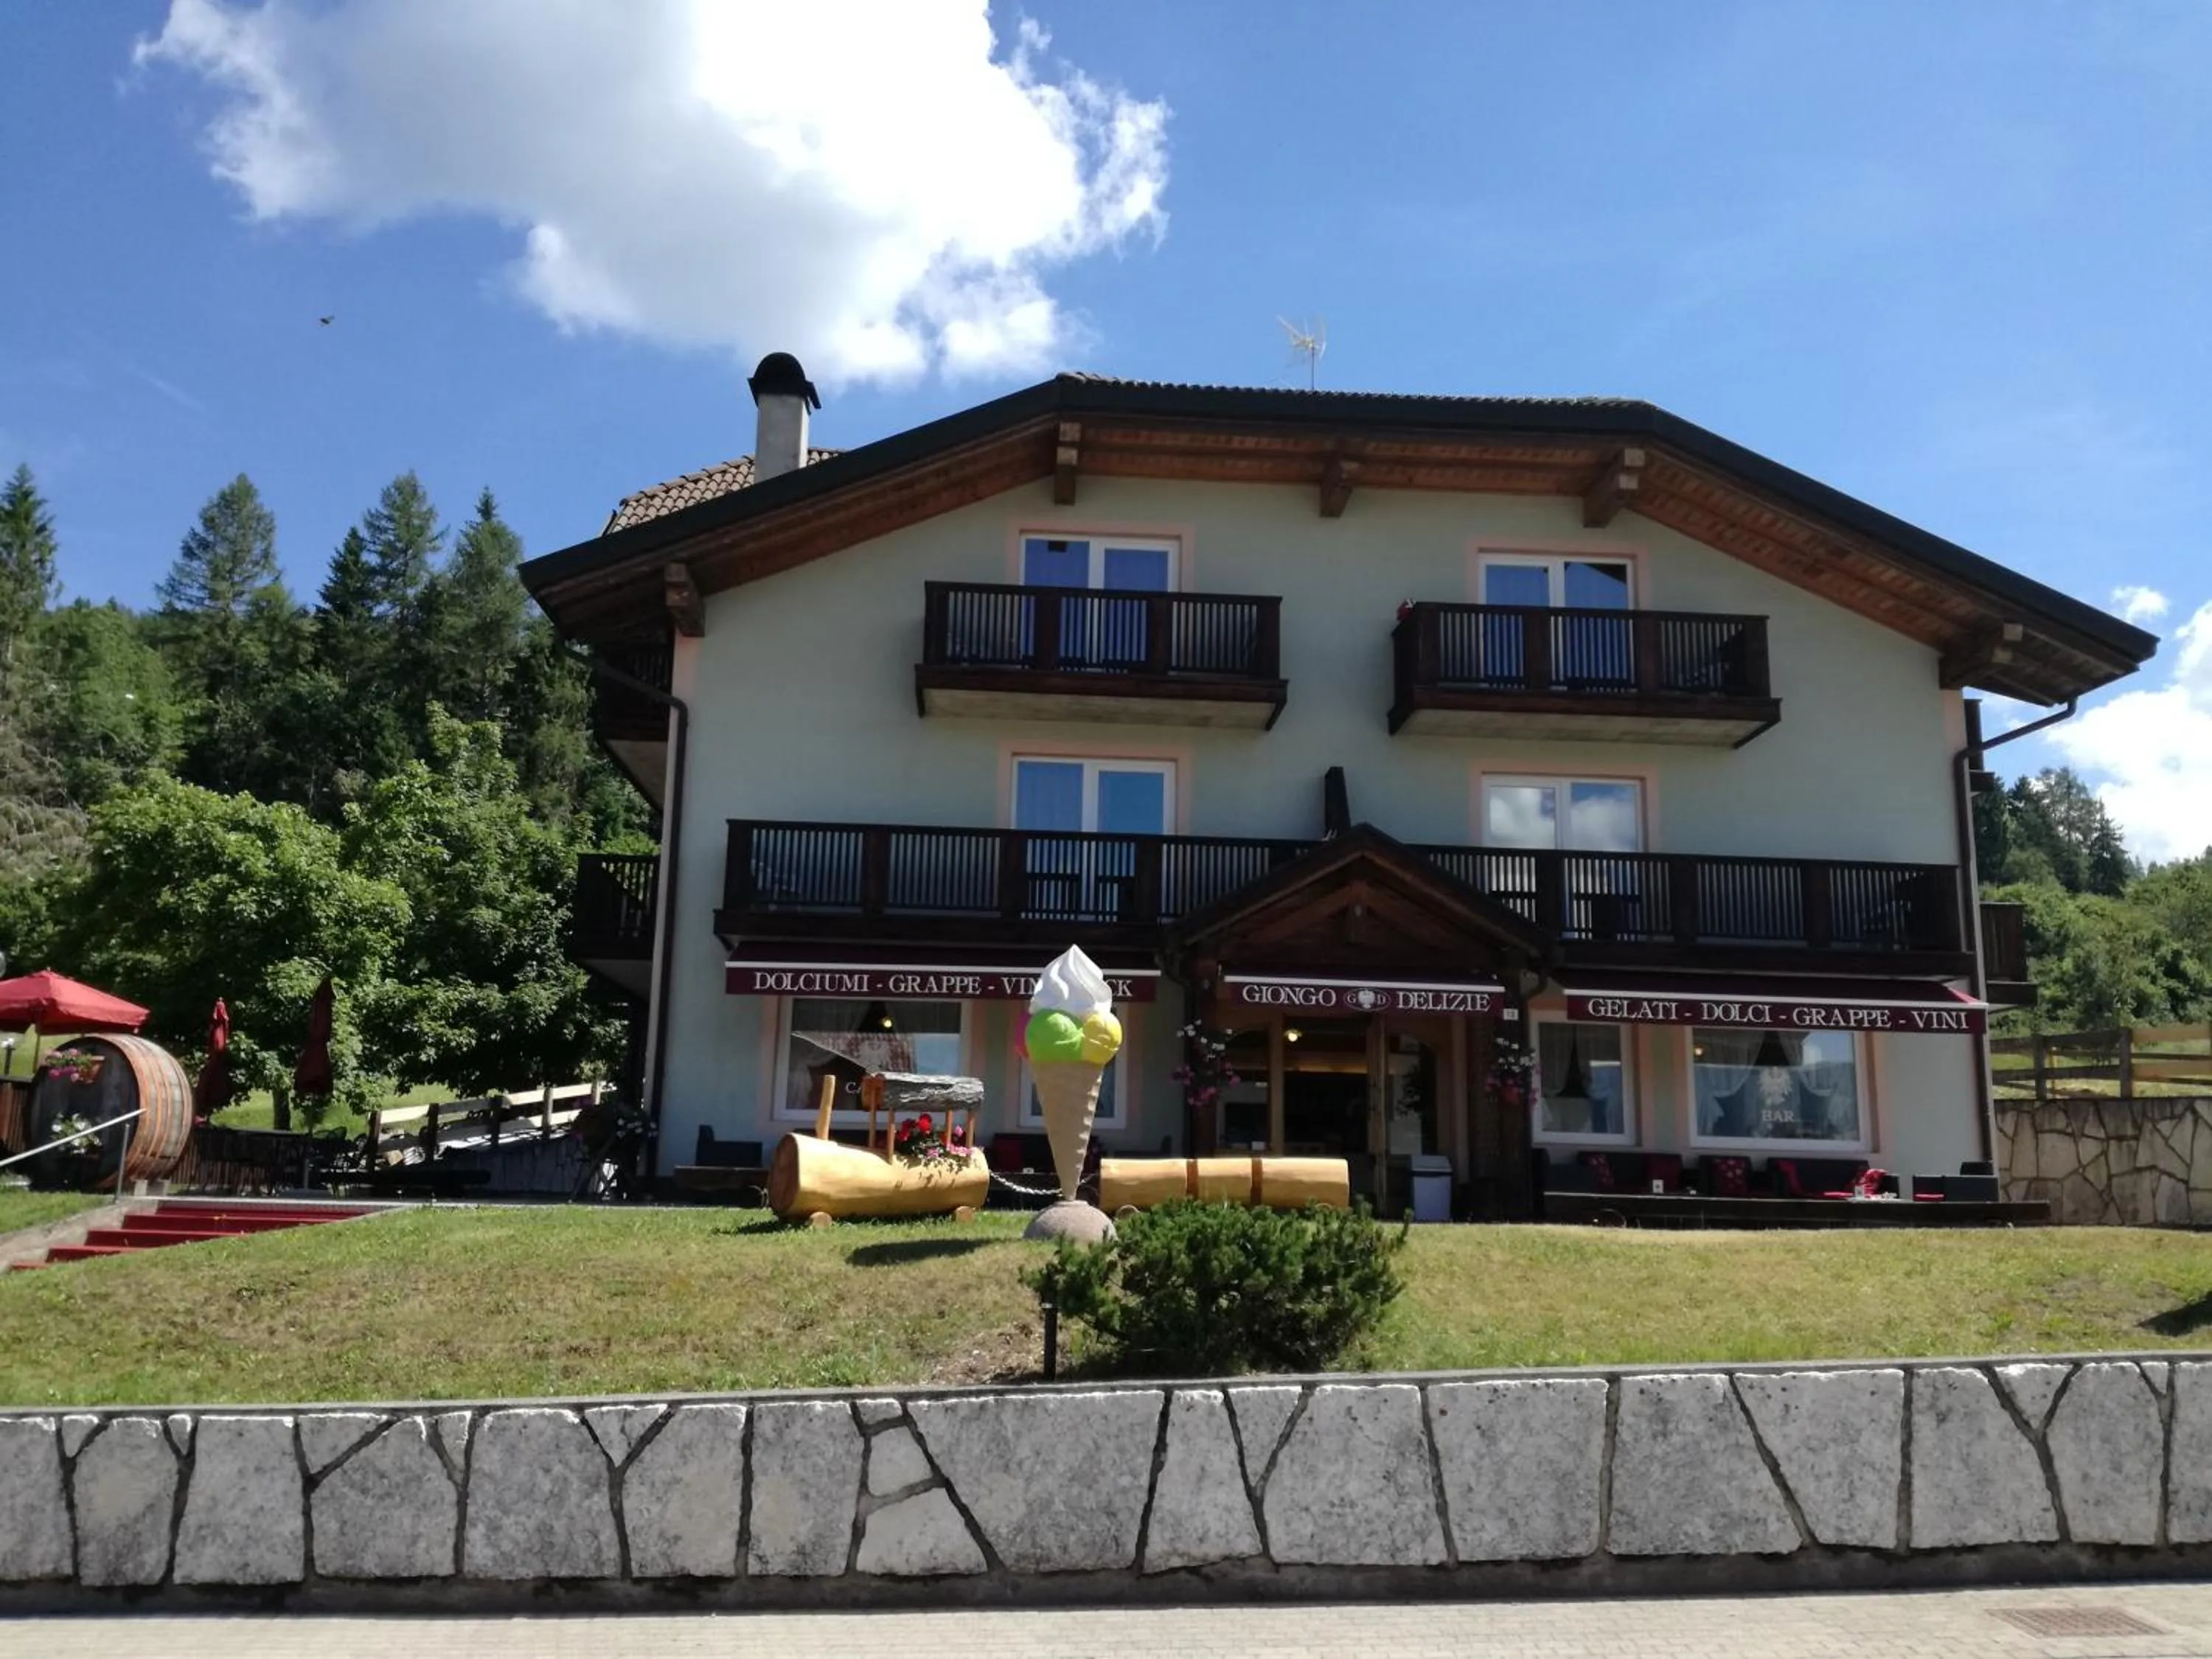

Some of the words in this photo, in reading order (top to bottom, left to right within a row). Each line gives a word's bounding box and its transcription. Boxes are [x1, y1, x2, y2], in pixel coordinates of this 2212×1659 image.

[754, 972, 869, 992] DOLCIUMI
[888, 974, 981, 995] GRAPPE
[1001, 976, 1037, 995] VIN
[1242, 985, 1337, 1006] GIONGO
[1397, 991, 1491, 1012] DELIZIE
[1587, 998, 1679, 1020] GELATI
[1701, 1003, 1773, 1023] DOLCI
[1792, 1006, 1892, 1028] GRAPPE
[1911, 1011, 1969, 1029] VINI
[1761, 1109, 1795, 1121] BAR
